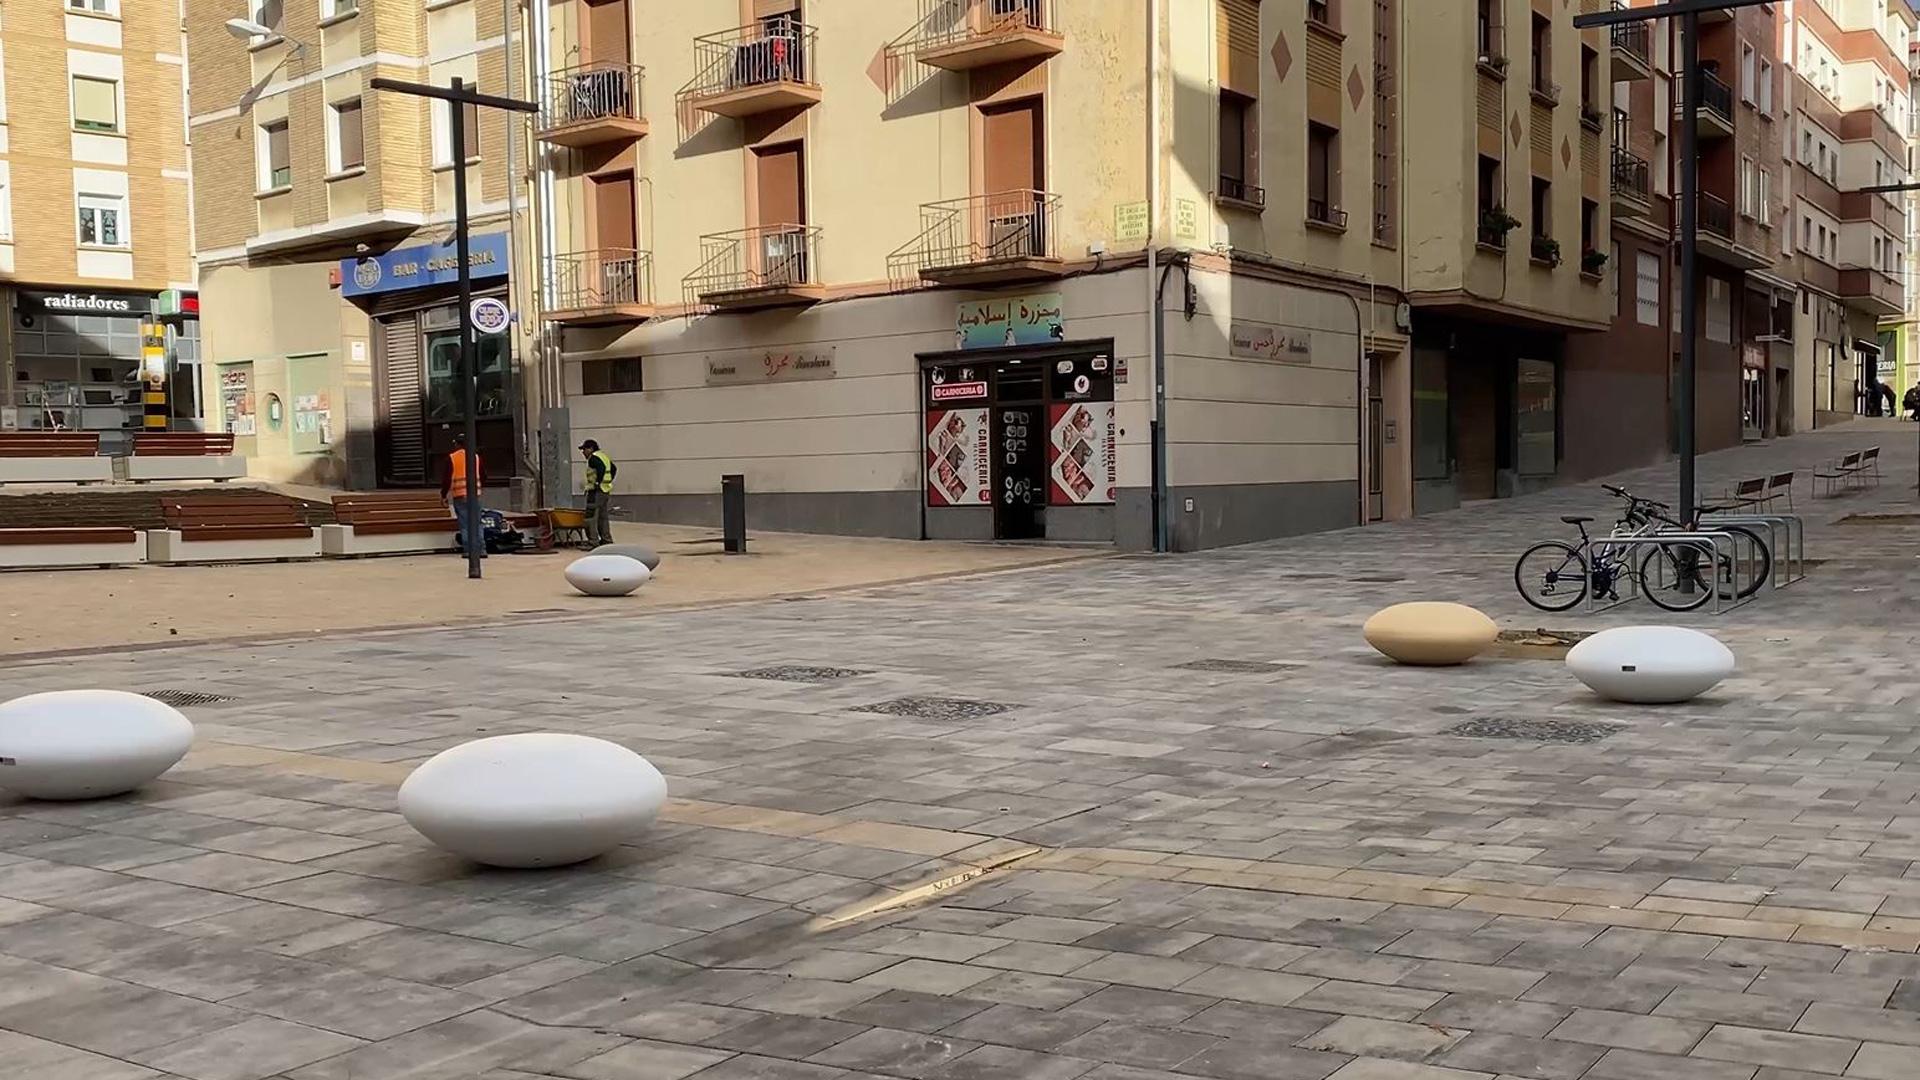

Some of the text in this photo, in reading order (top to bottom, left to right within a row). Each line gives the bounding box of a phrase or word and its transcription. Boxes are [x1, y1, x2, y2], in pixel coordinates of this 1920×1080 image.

[393, 262, 418, 278] BAR
[427, 250, 496, 273] CAFEERIA
[43, 293, 129, 311] radiadores
[1020, 299, 1060, 325] مجزرة
[978, 428, 988, 486] CARNICERIA
